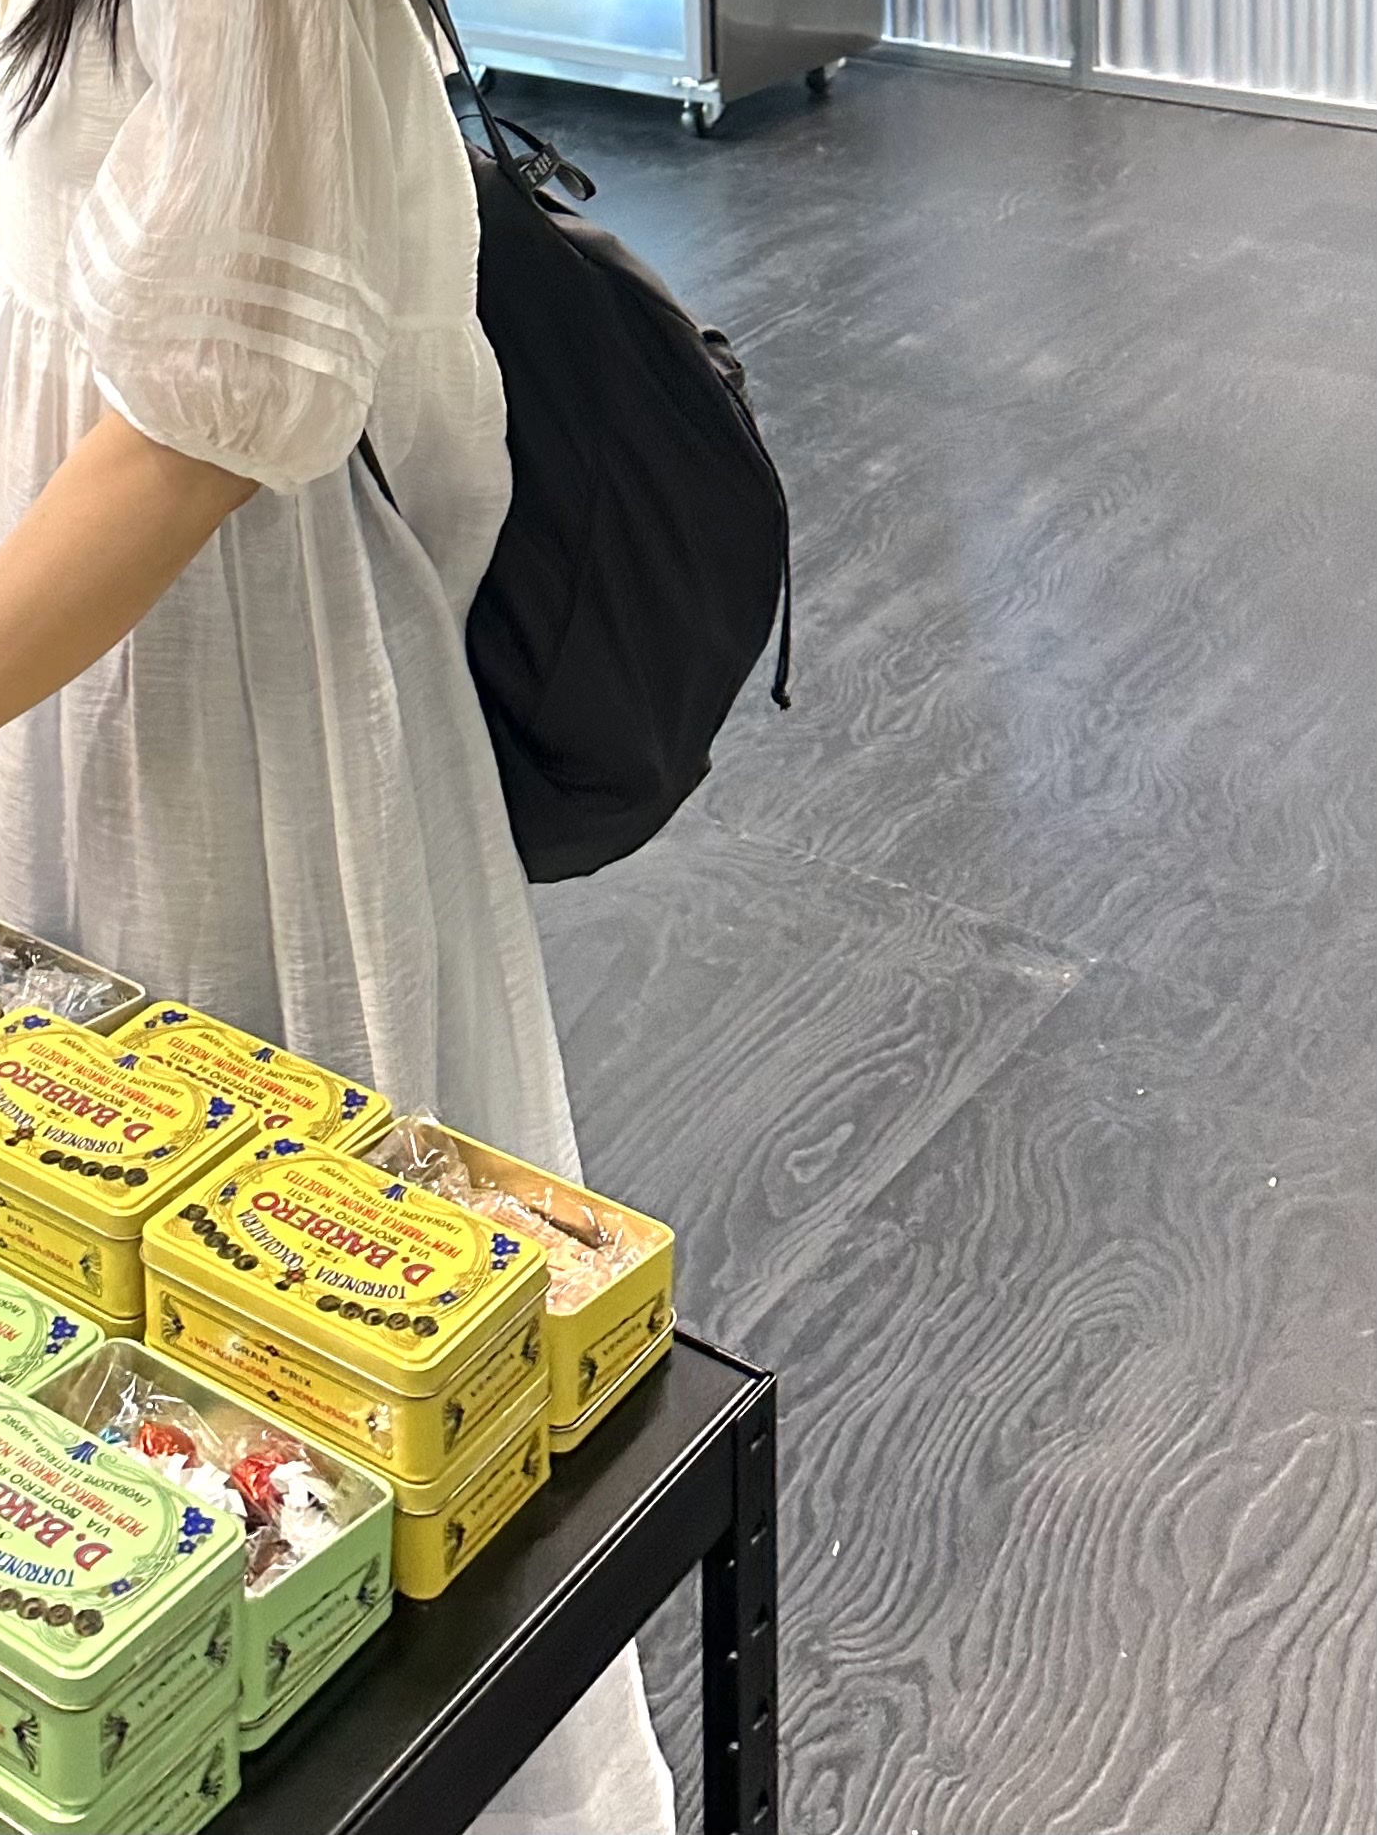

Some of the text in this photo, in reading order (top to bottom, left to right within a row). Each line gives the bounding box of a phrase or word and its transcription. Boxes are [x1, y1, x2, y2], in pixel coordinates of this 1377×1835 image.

[285, 1187, 315, 1202] ASTI
[7, 1214, 34, 1235] PRIX
[250, 1192, 436, 1286] D. BARBERO
[334, 1210, 403, 1246] BROFFERIO
[408, 1244, 431, 1259] VIA
[312, 1265, 403, 1299] TORRONERIA
[279, 1365, 311, 1389] PRIX
[8, 1472, 82, 1519] BROFFERIO
[85, 1517, 111, 1537] VIA
[73, 1531, 113, 1572] D.
